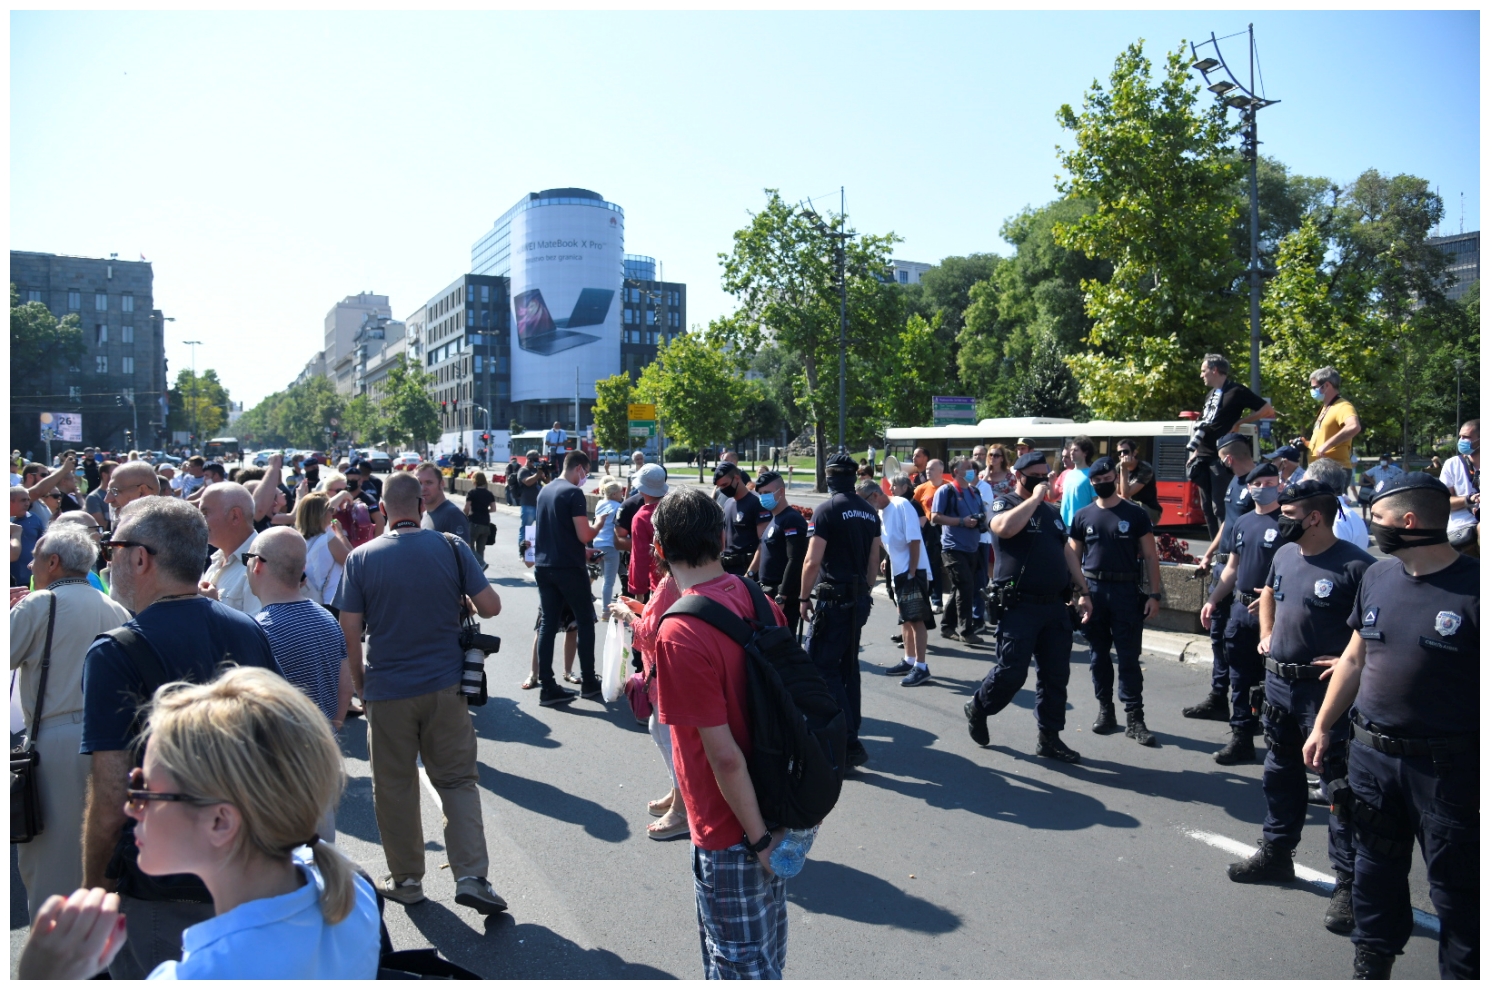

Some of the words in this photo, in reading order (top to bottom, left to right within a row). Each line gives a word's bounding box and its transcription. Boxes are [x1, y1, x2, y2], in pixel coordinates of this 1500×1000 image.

[537, 239, 578, 249] MateBook
[581, 240, 587, 249] X
[59, 416, 72, 426] 26
[842, 509, 876, 523] ПОЛИЦИЈА
